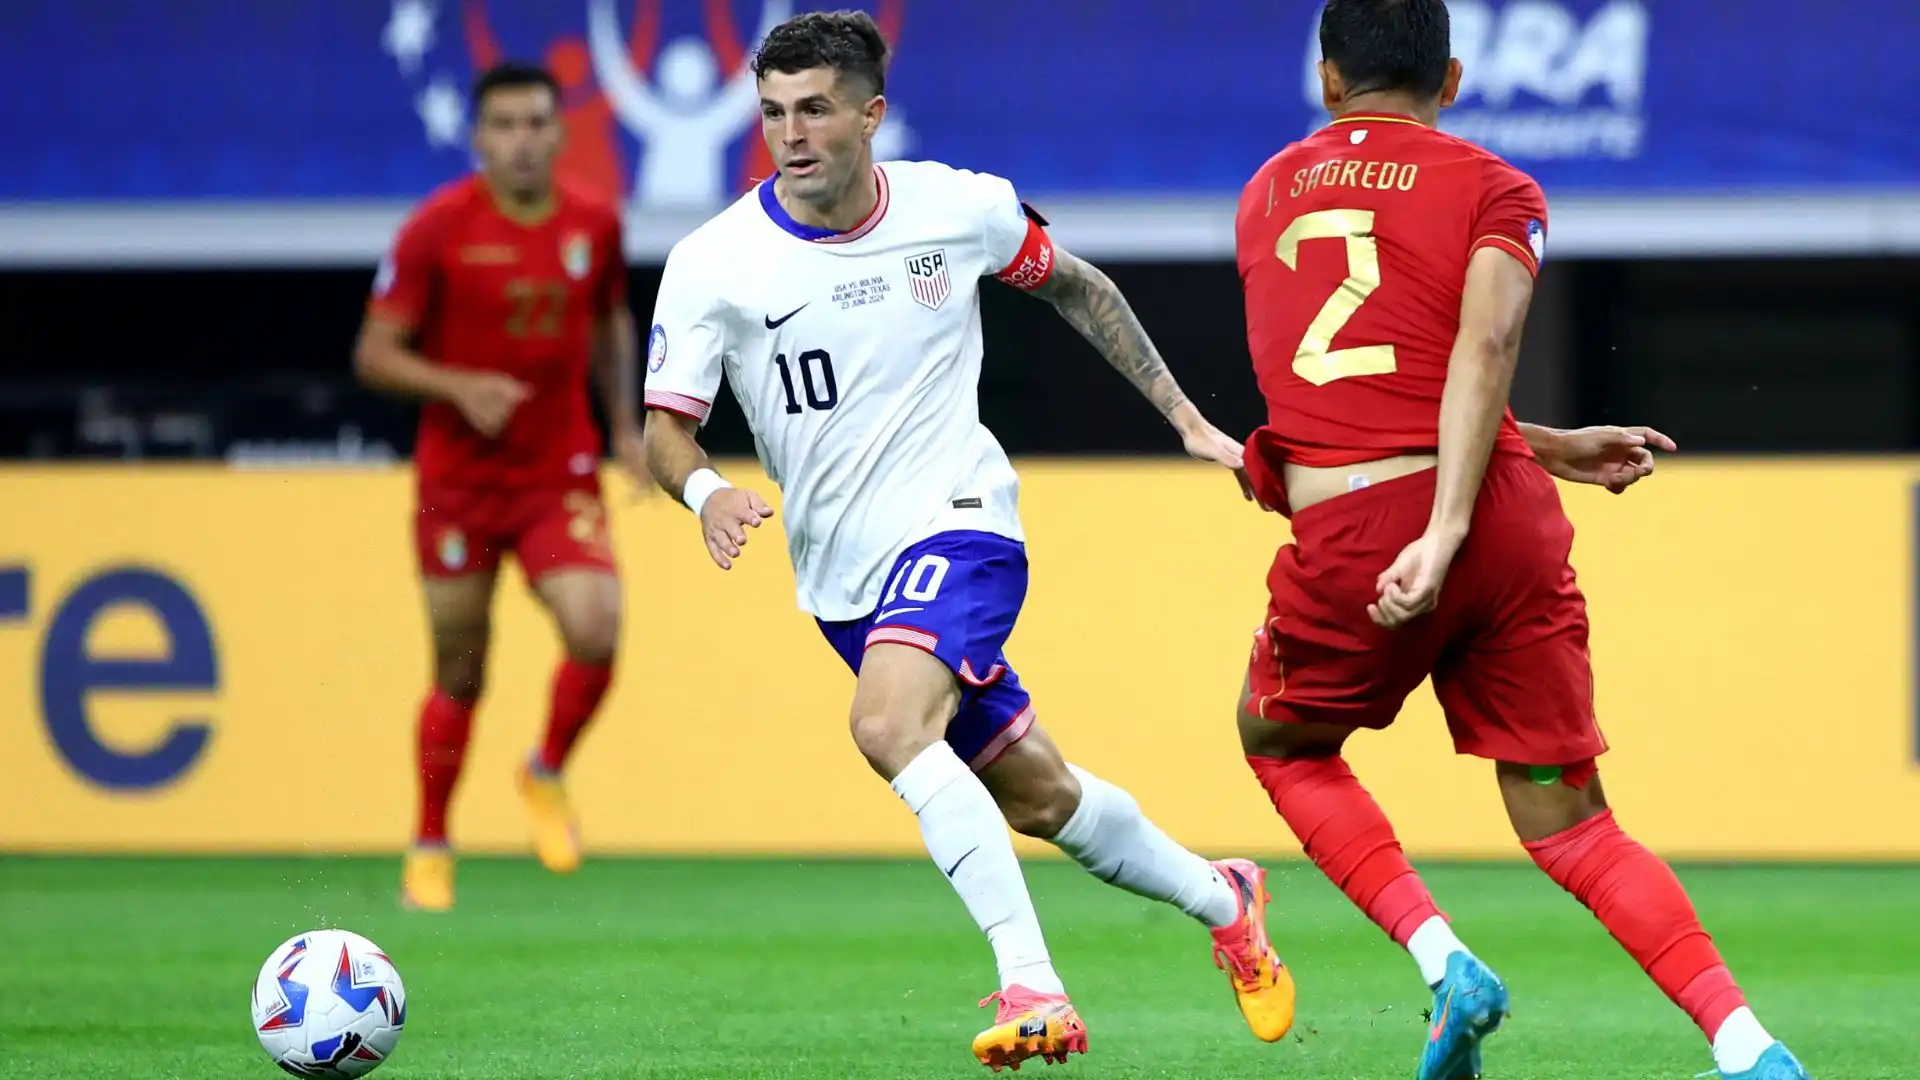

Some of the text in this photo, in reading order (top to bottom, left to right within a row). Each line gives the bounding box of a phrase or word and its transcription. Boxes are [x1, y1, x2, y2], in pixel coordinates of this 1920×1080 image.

[1265, 159, 1419, 217] J. SAGREDO
[834, 276, 883, 293] USA VS BOLIVIA
[870, 284, 891, 293] TEXAS
[908, 253, 944, 278] USA
[504, 277, 568, 339] 22
[1274, 208, 1398, 387] 2
[774, 349, 839, 415] 10
[882, 554, 951, 607] 10
